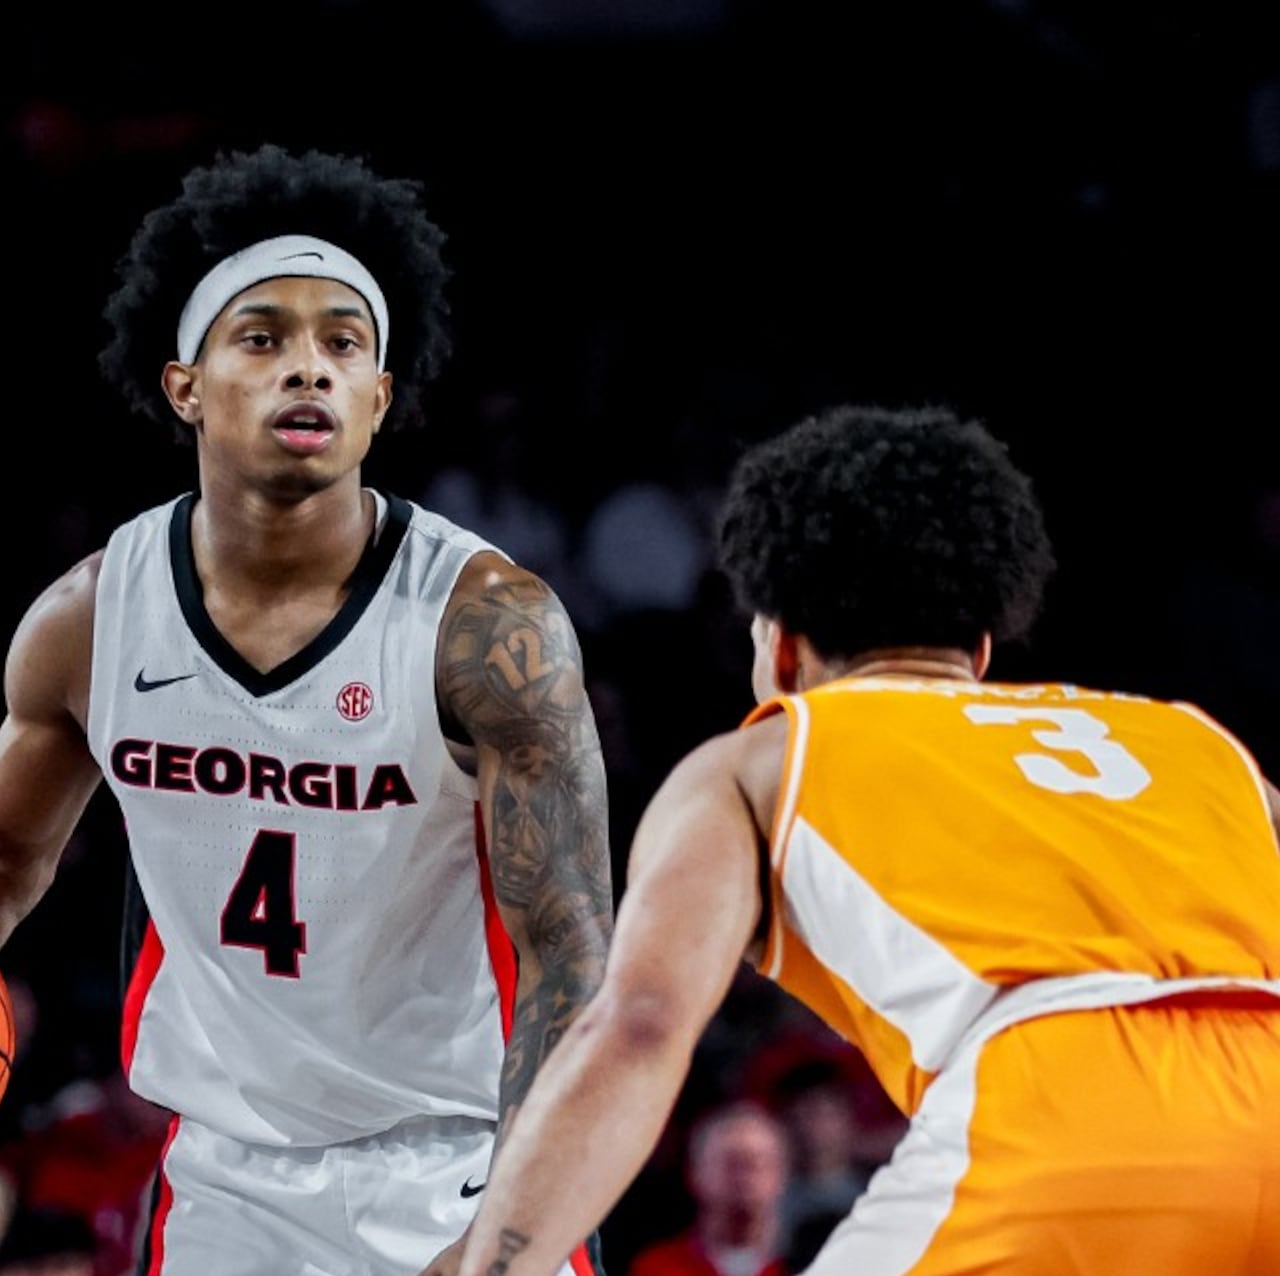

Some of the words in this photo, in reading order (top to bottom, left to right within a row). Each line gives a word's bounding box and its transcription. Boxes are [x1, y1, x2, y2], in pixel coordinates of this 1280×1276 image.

[485, 628, 555, 690] 12
[341, 685, 371, 717] SEC
[110, 738, 418, 811] GEORGIA
[961, 703, 1152, 800] 3
[220, 829, 306, 978] 4
